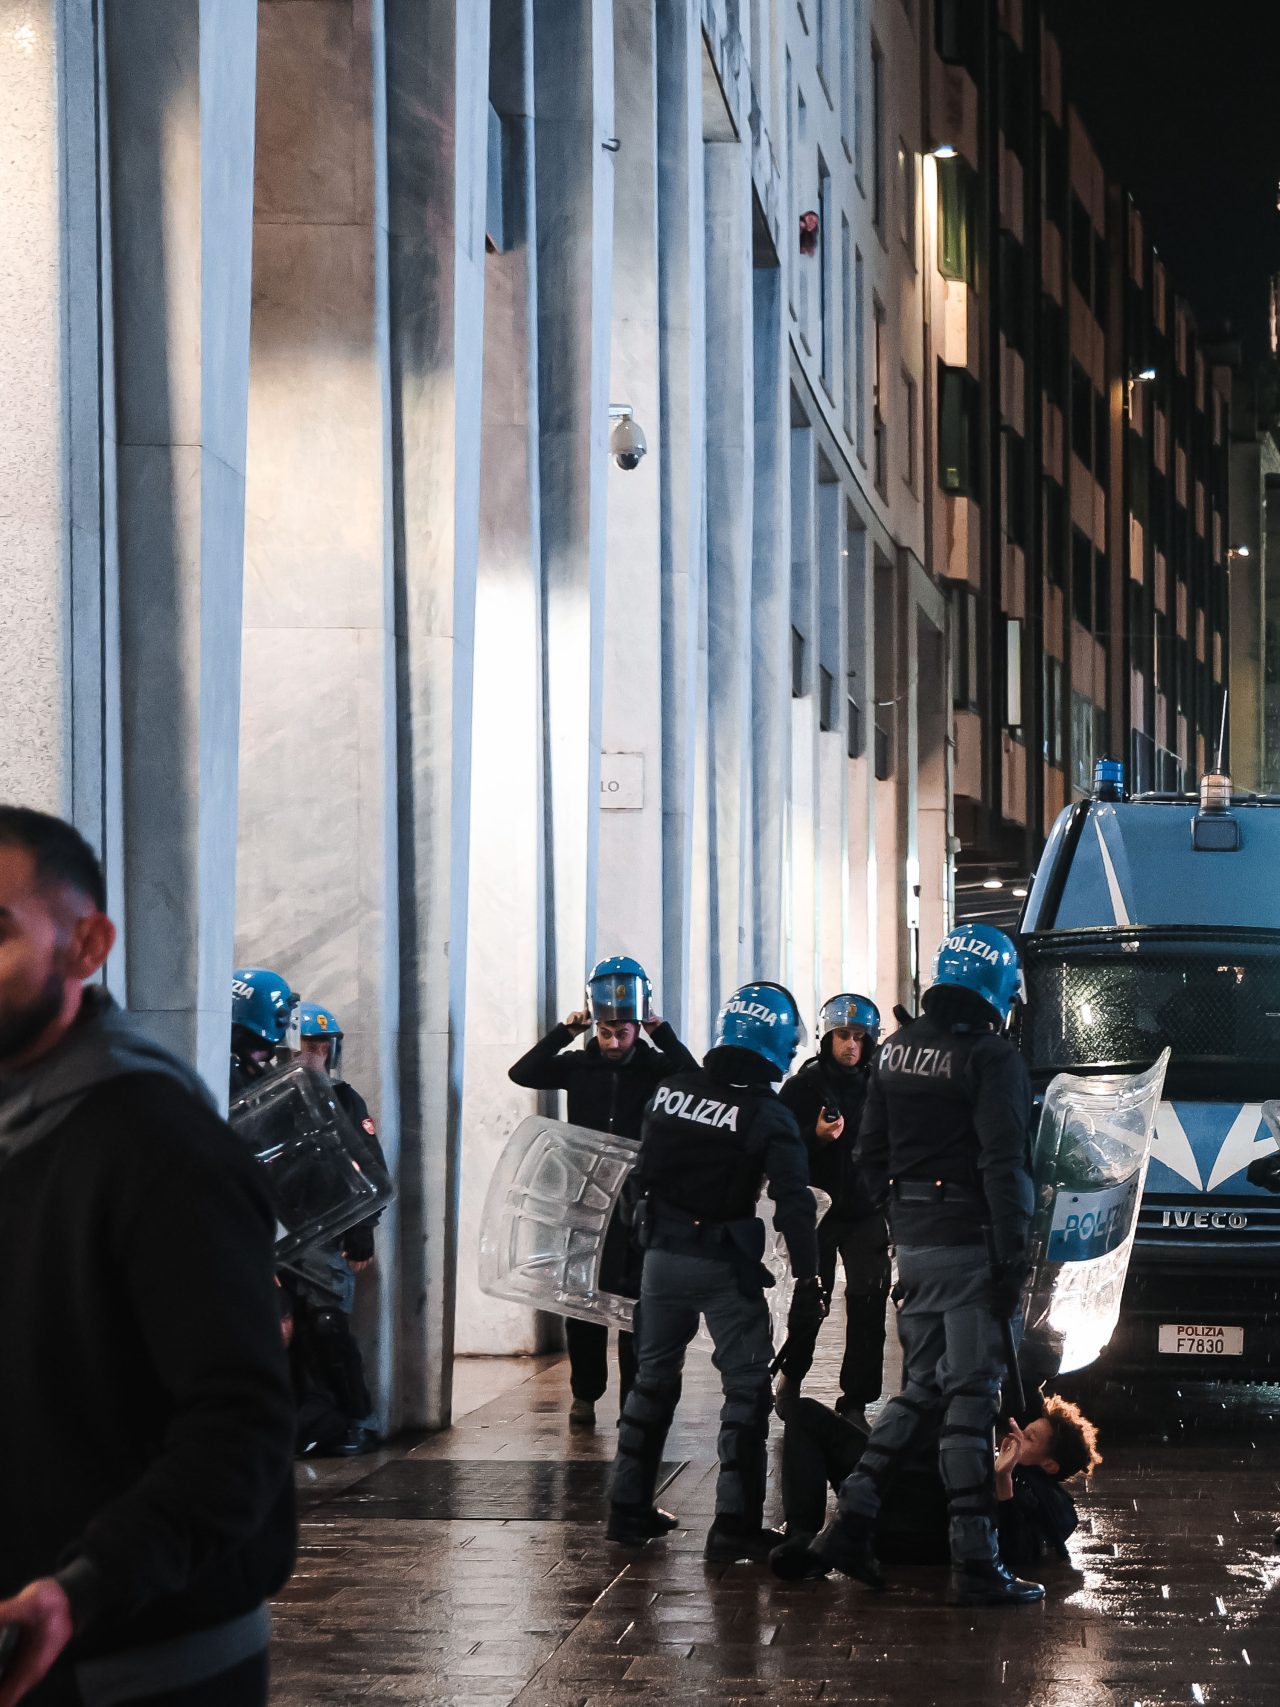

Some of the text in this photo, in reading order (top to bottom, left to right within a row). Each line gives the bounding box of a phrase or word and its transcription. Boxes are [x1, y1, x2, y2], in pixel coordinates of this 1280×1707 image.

[941, 936, 1000, 966] POLIZIA
[878, 1043, 951, 1079] POLIZIA
[652, 1086, 740, 1132] POLIZIA
[1162, 1211, 1248, 1229] IVECO
[1176, 1326, 1224, 1337] POLIZIA
[1176, 1339, 1224, 1354] F7830
